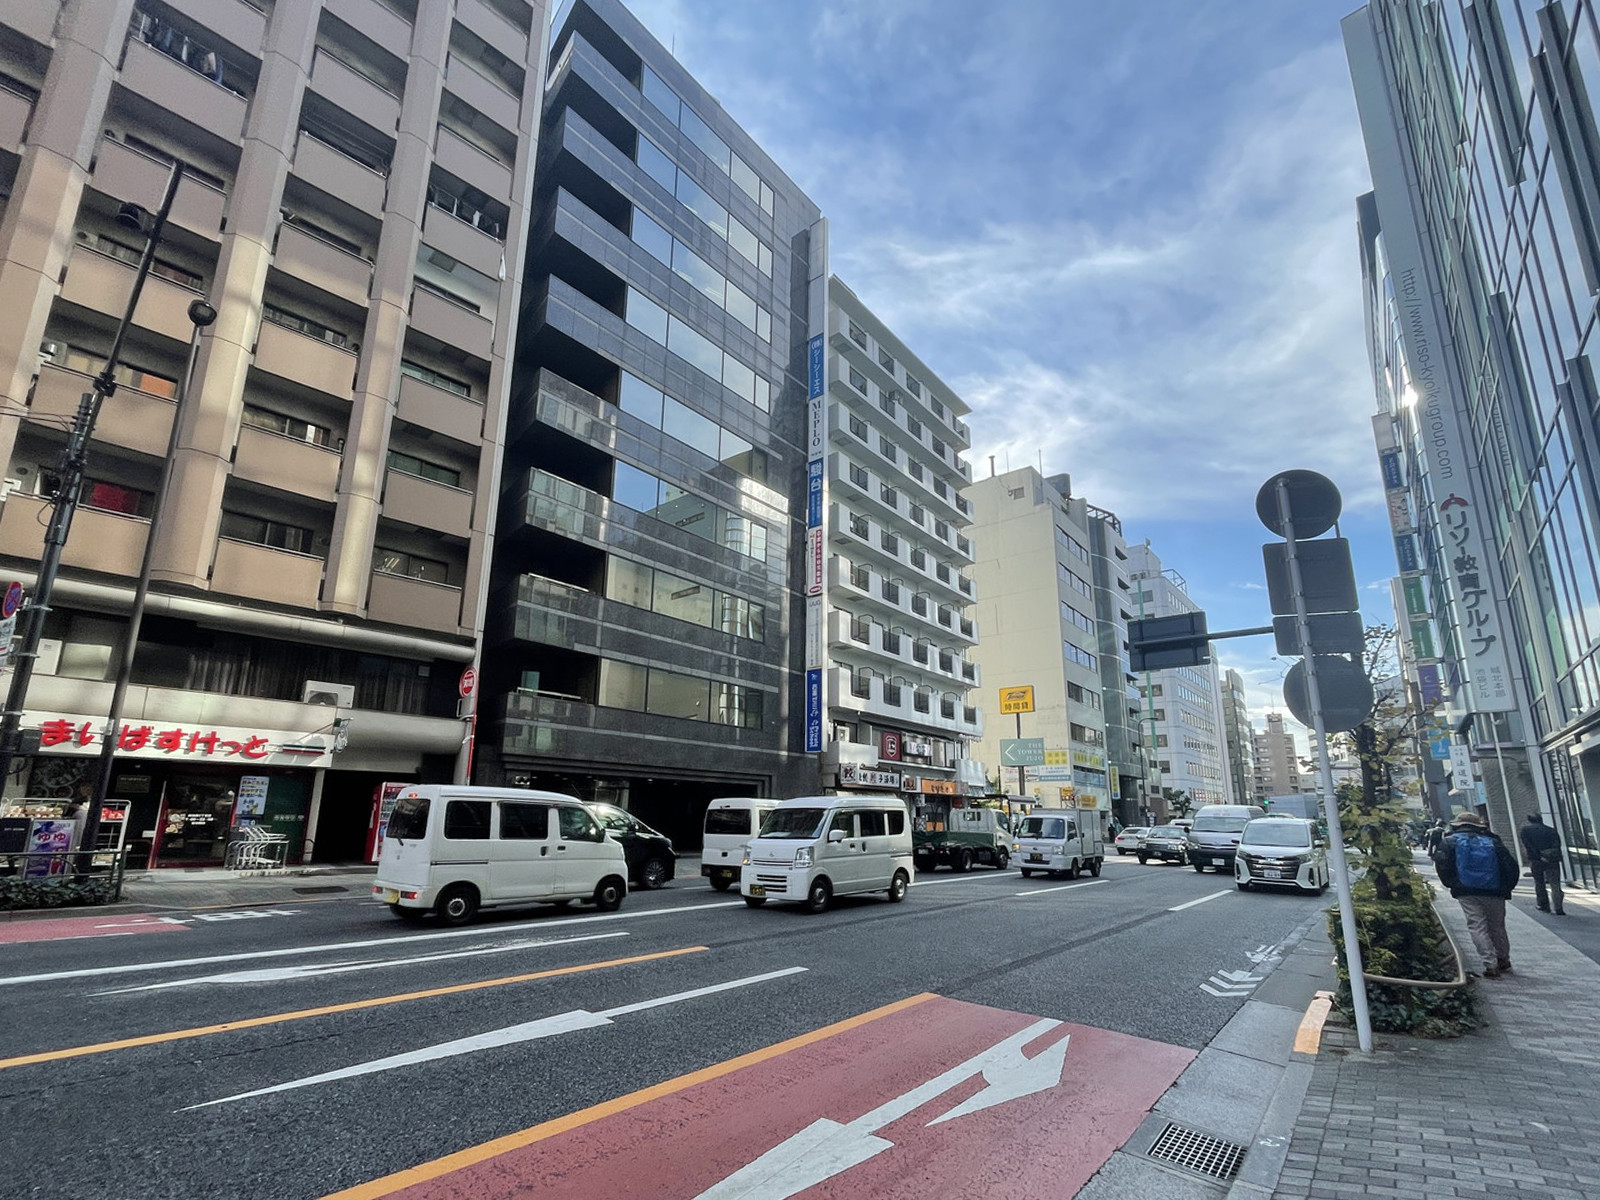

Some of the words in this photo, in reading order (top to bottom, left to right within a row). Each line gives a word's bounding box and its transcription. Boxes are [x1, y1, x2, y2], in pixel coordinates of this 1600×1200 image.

[811, 400, 821, 447] MEPLO
[1446, 511, 1497, 657] リソー教育グループ
